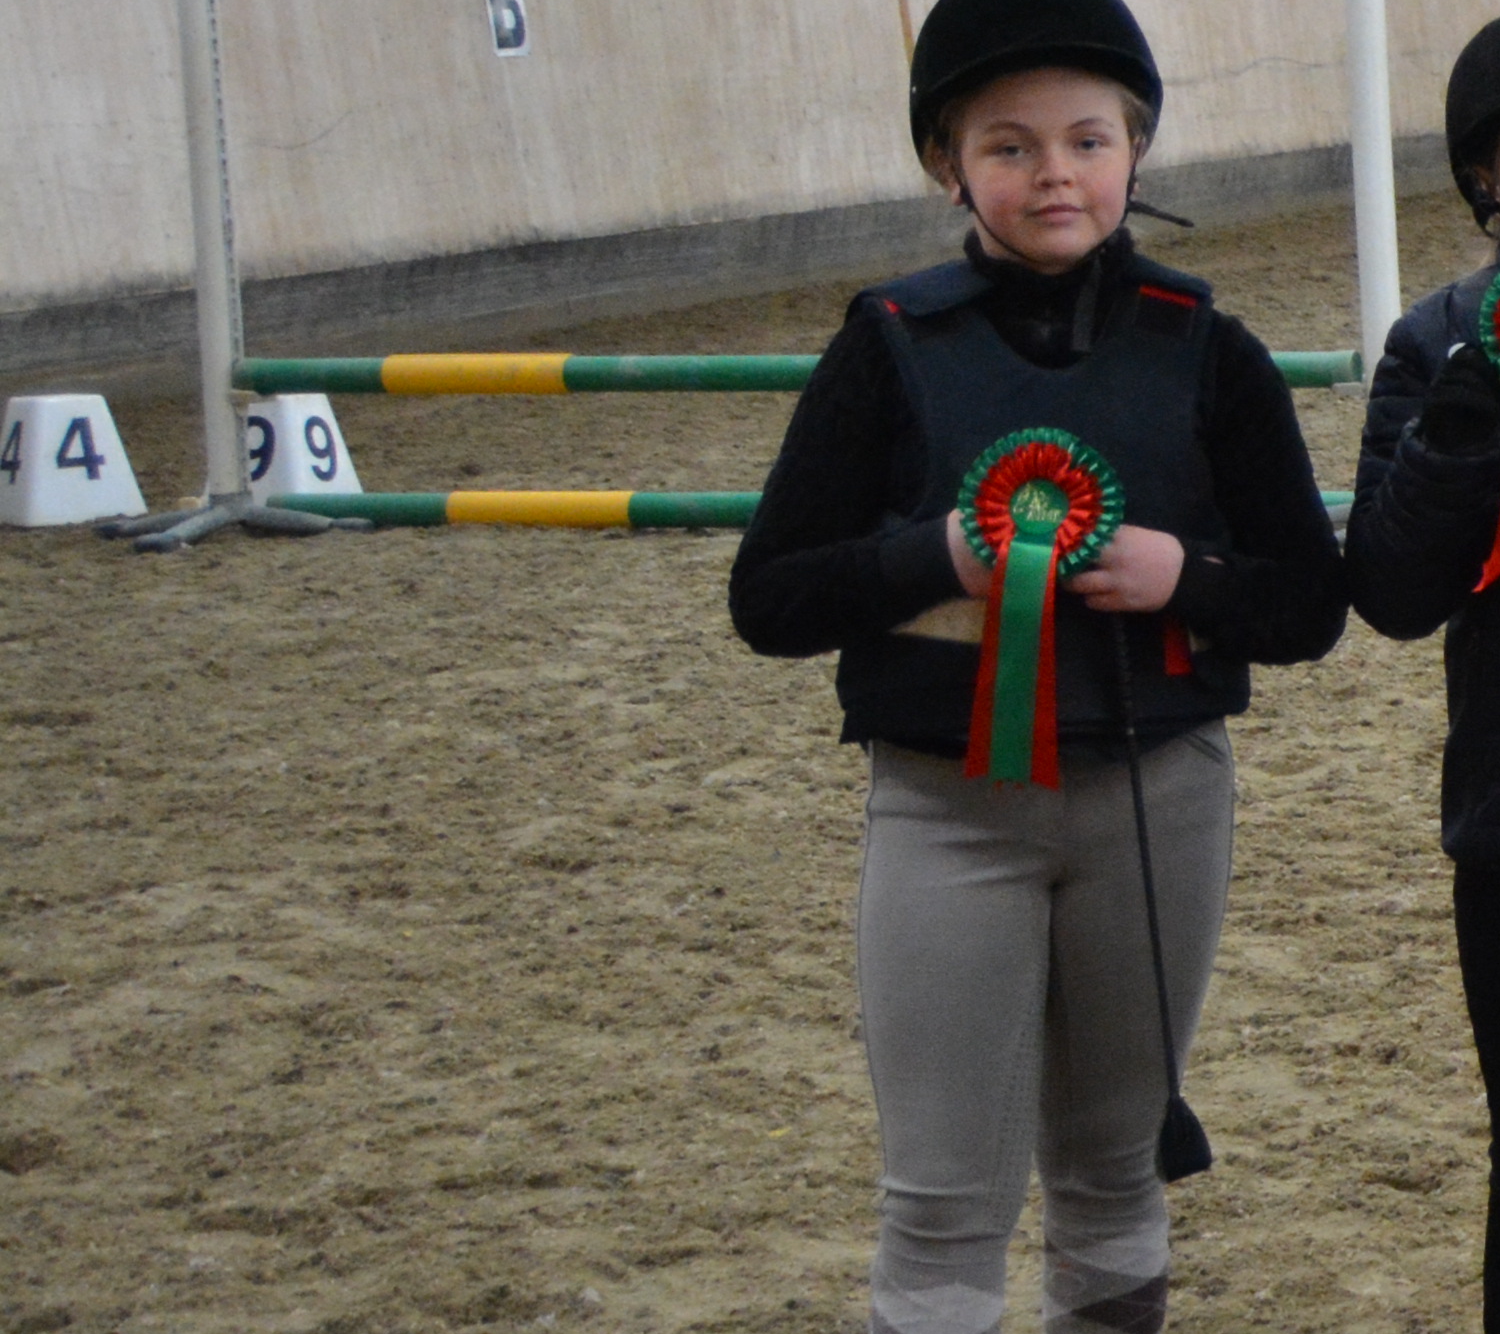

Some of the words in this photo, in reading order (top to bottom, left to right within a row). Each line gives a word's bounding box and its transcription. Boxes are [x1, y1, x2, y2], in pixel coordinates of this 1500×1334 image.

[1, 419, 23, 485] 4
[56, 416, 106, 481] 4
[304, 415, 338, 482] 9
